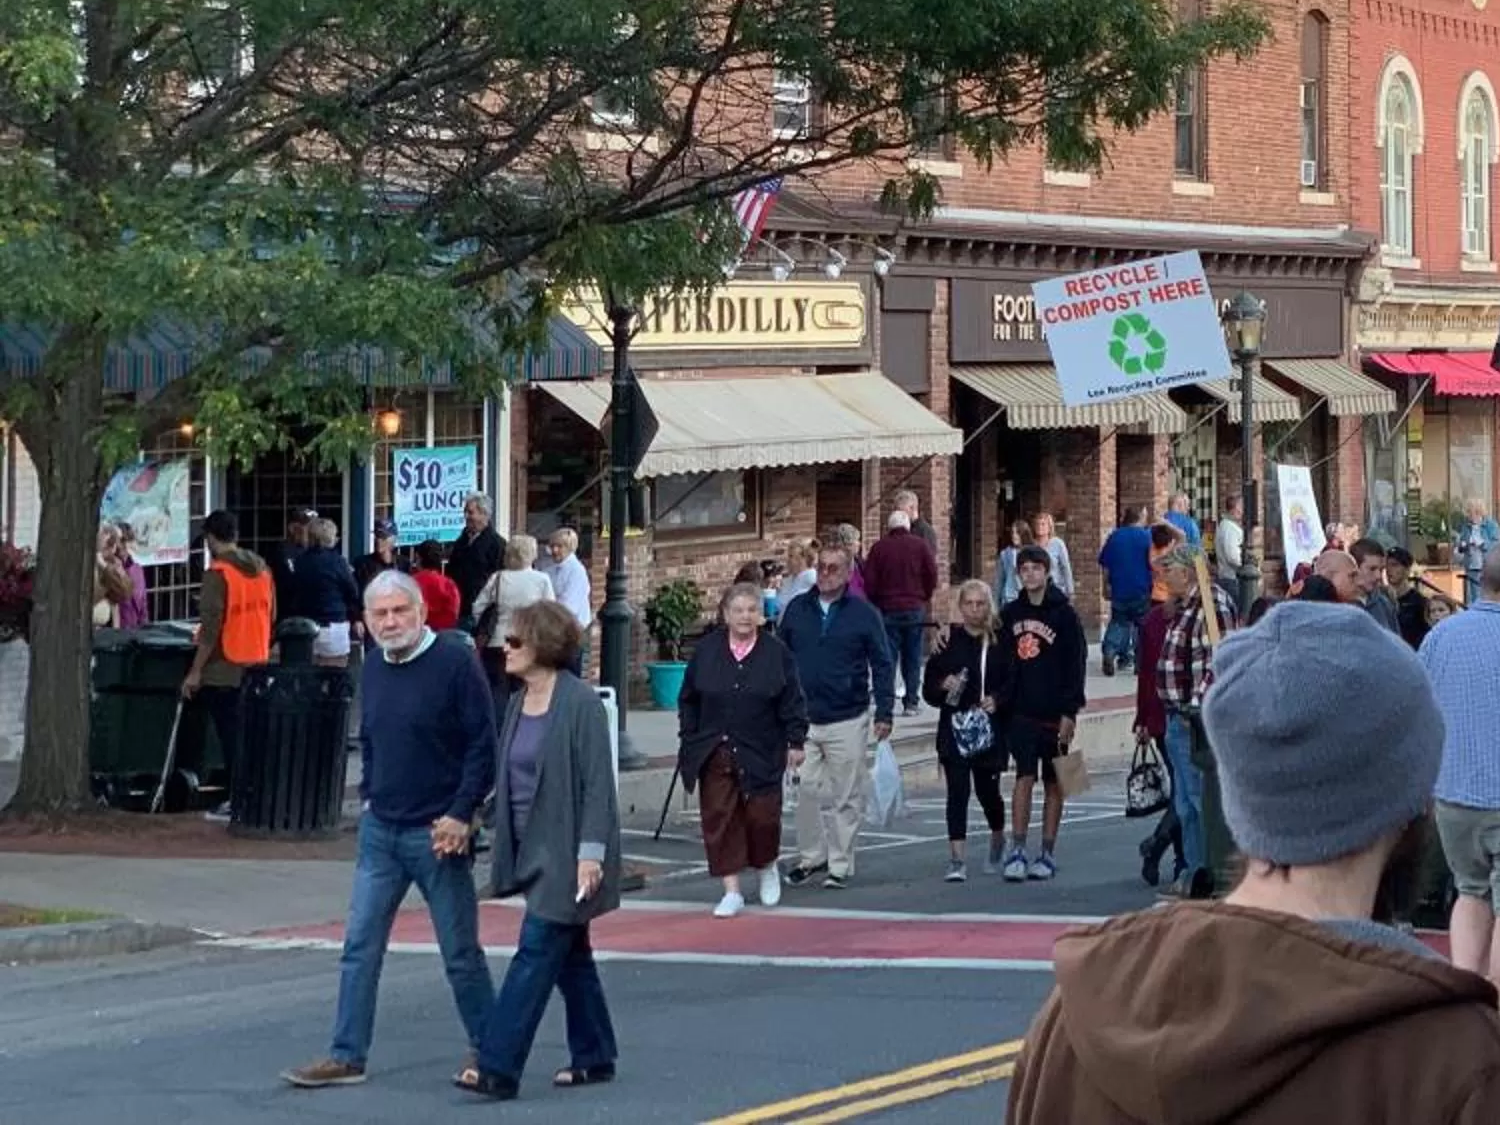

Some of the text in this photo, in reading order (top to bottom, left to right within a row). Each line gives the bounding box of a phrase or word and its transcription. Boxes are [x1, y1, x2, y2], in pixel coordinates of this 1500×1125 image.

[1065, 263, 1159, 296] RECYCLE
[1044, 278, 1205, 323] COMPOST HERE
[1107, 378, 1153, 396] Recycling
[1155, 369, 1208, 386] Committee
[398, 457, 442, 492] $10
